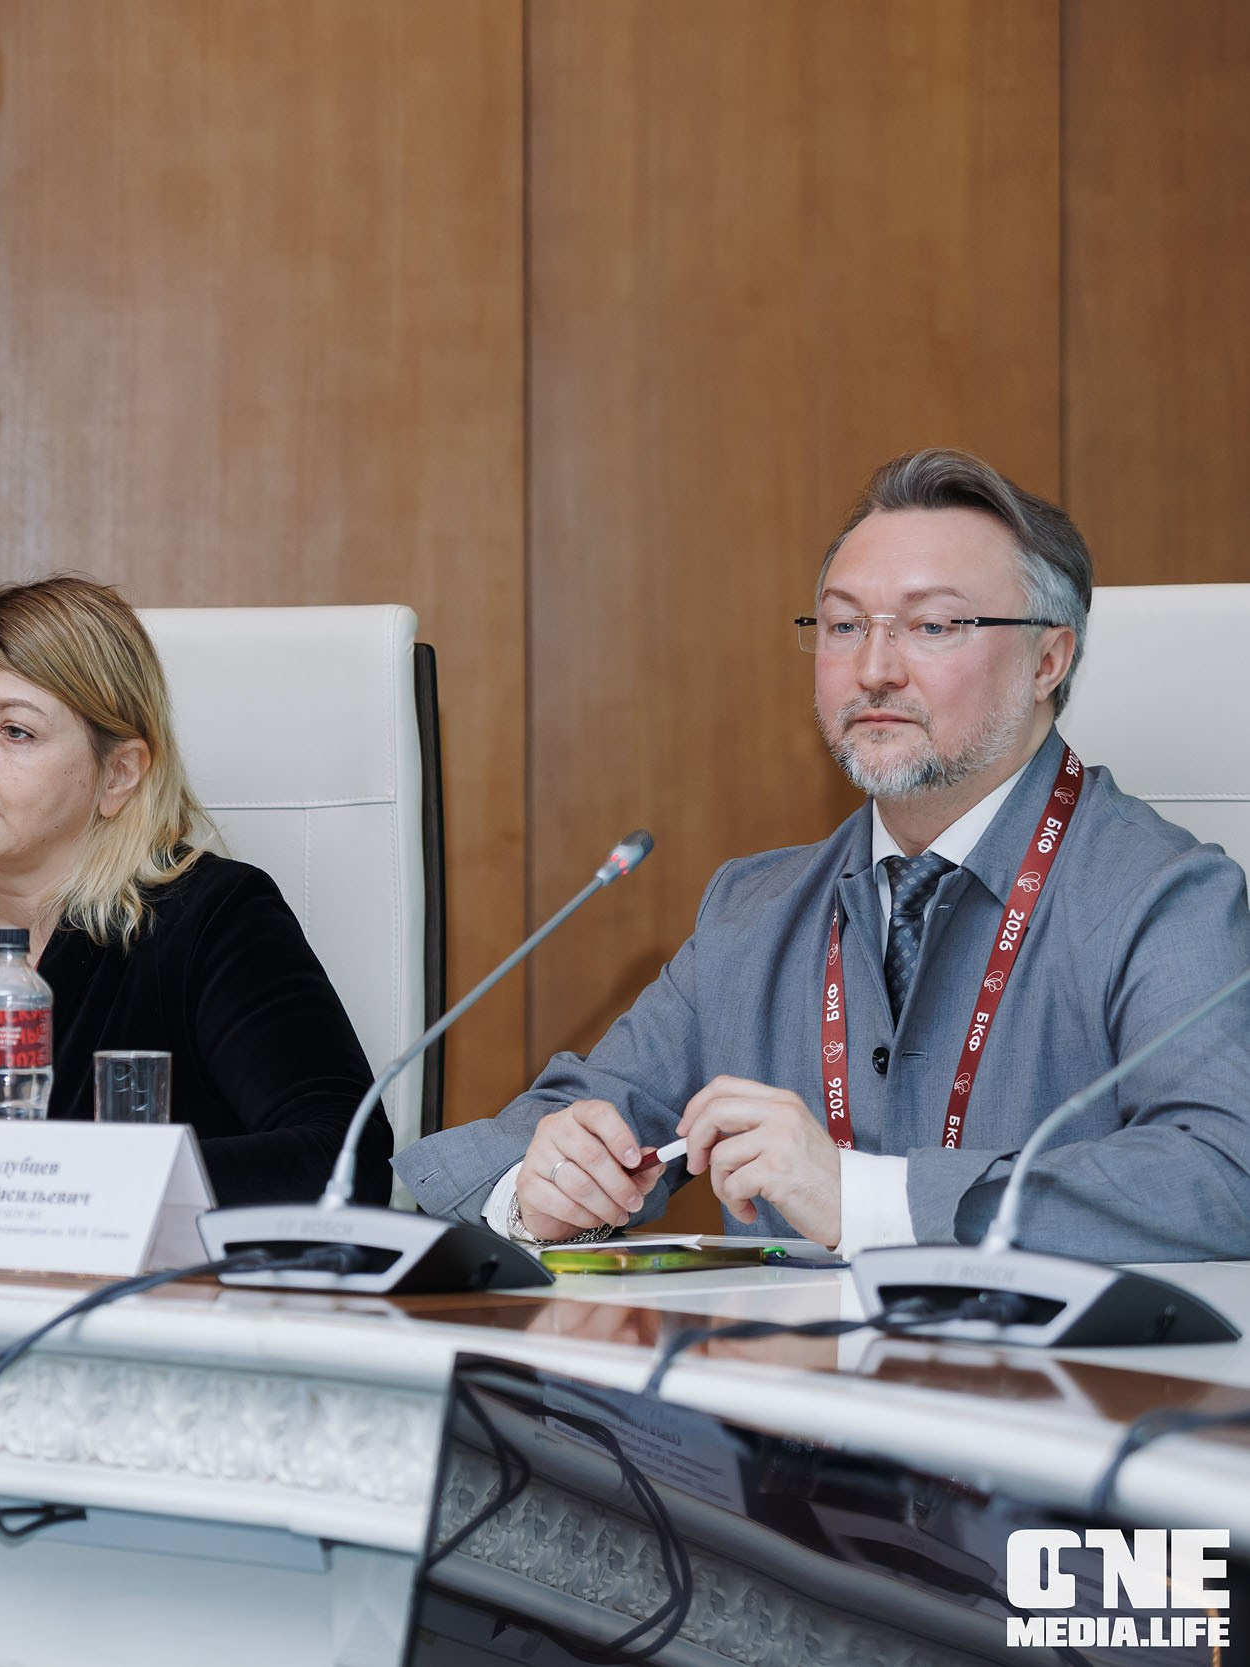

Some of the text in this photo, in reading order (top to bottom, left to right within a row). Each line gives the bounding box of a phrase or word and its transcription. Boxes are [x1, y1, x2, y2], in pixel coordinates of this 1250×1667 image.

[1037, 817, 1062, 855] БКФ
[998, 908, 1025, 952] 2026
[825, 983, 845, 1120] БКФ 2026
[968, 1011, 989, 1052] БКФ
